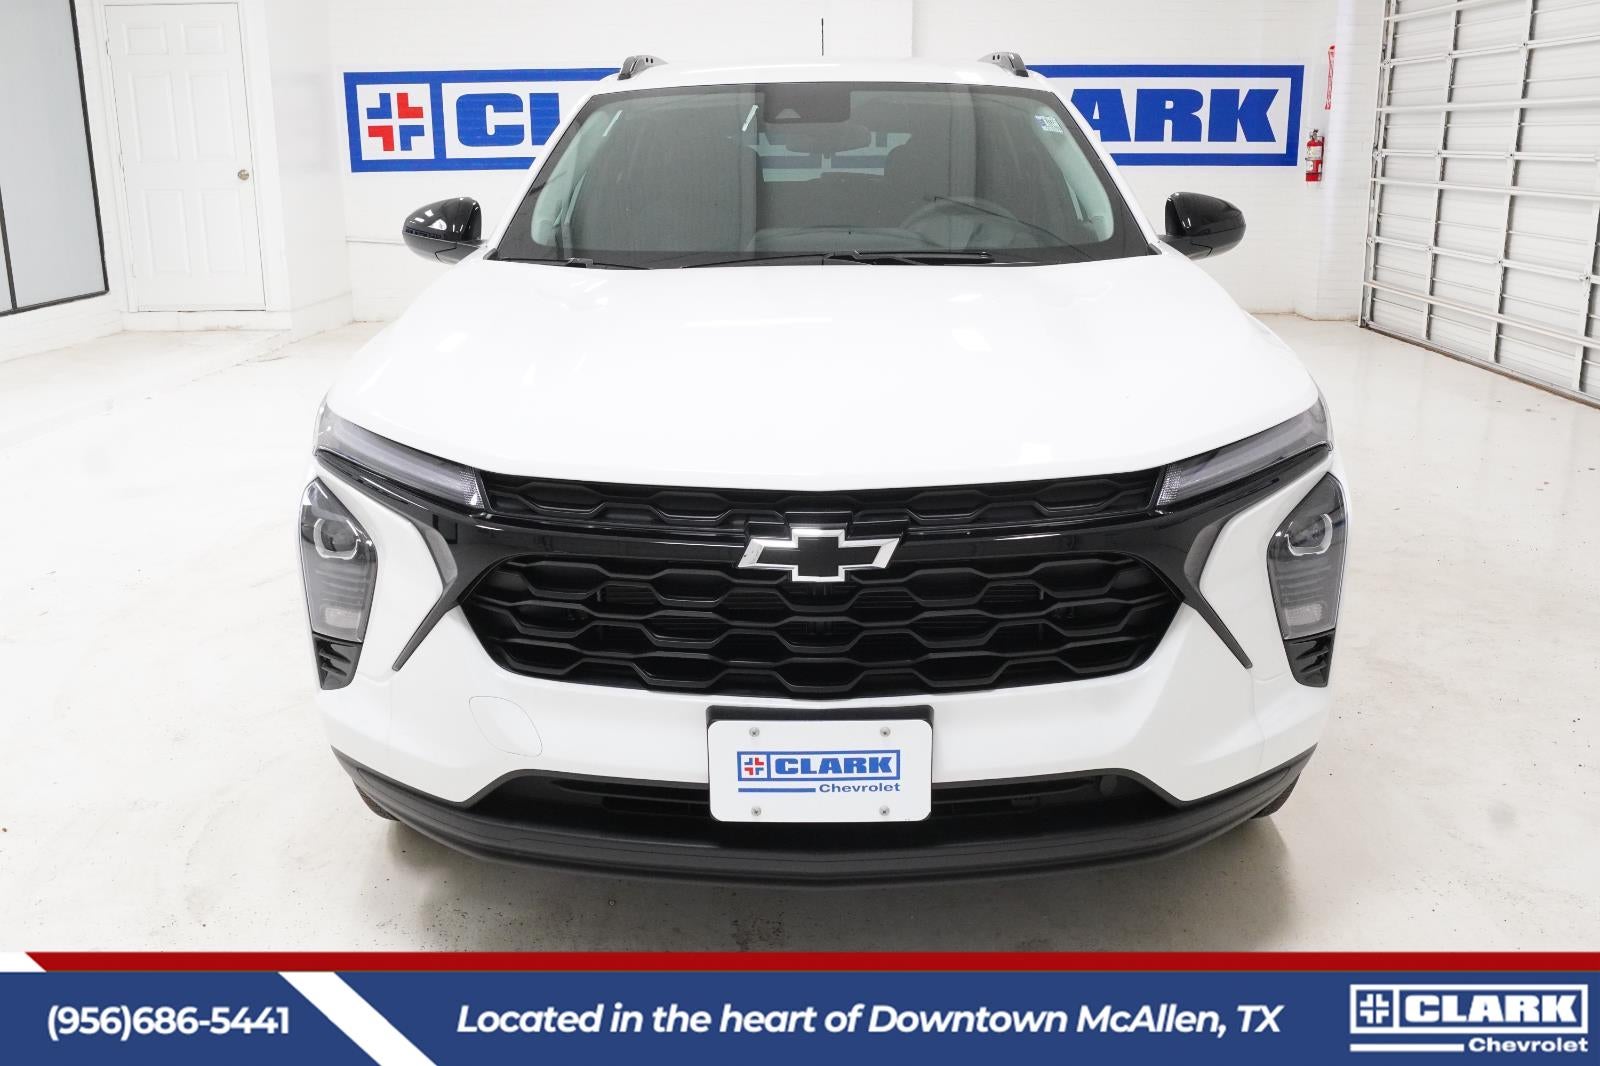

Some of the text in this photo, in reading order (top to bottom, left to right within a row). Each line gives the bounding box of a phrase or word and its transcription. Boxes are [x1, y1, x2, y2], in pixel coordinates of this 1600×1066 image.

[1070, 87, 1280, 143] ARK
[774, 756, 893, 775] CLARK
[819, 782, 901, 793] Chevrolet
